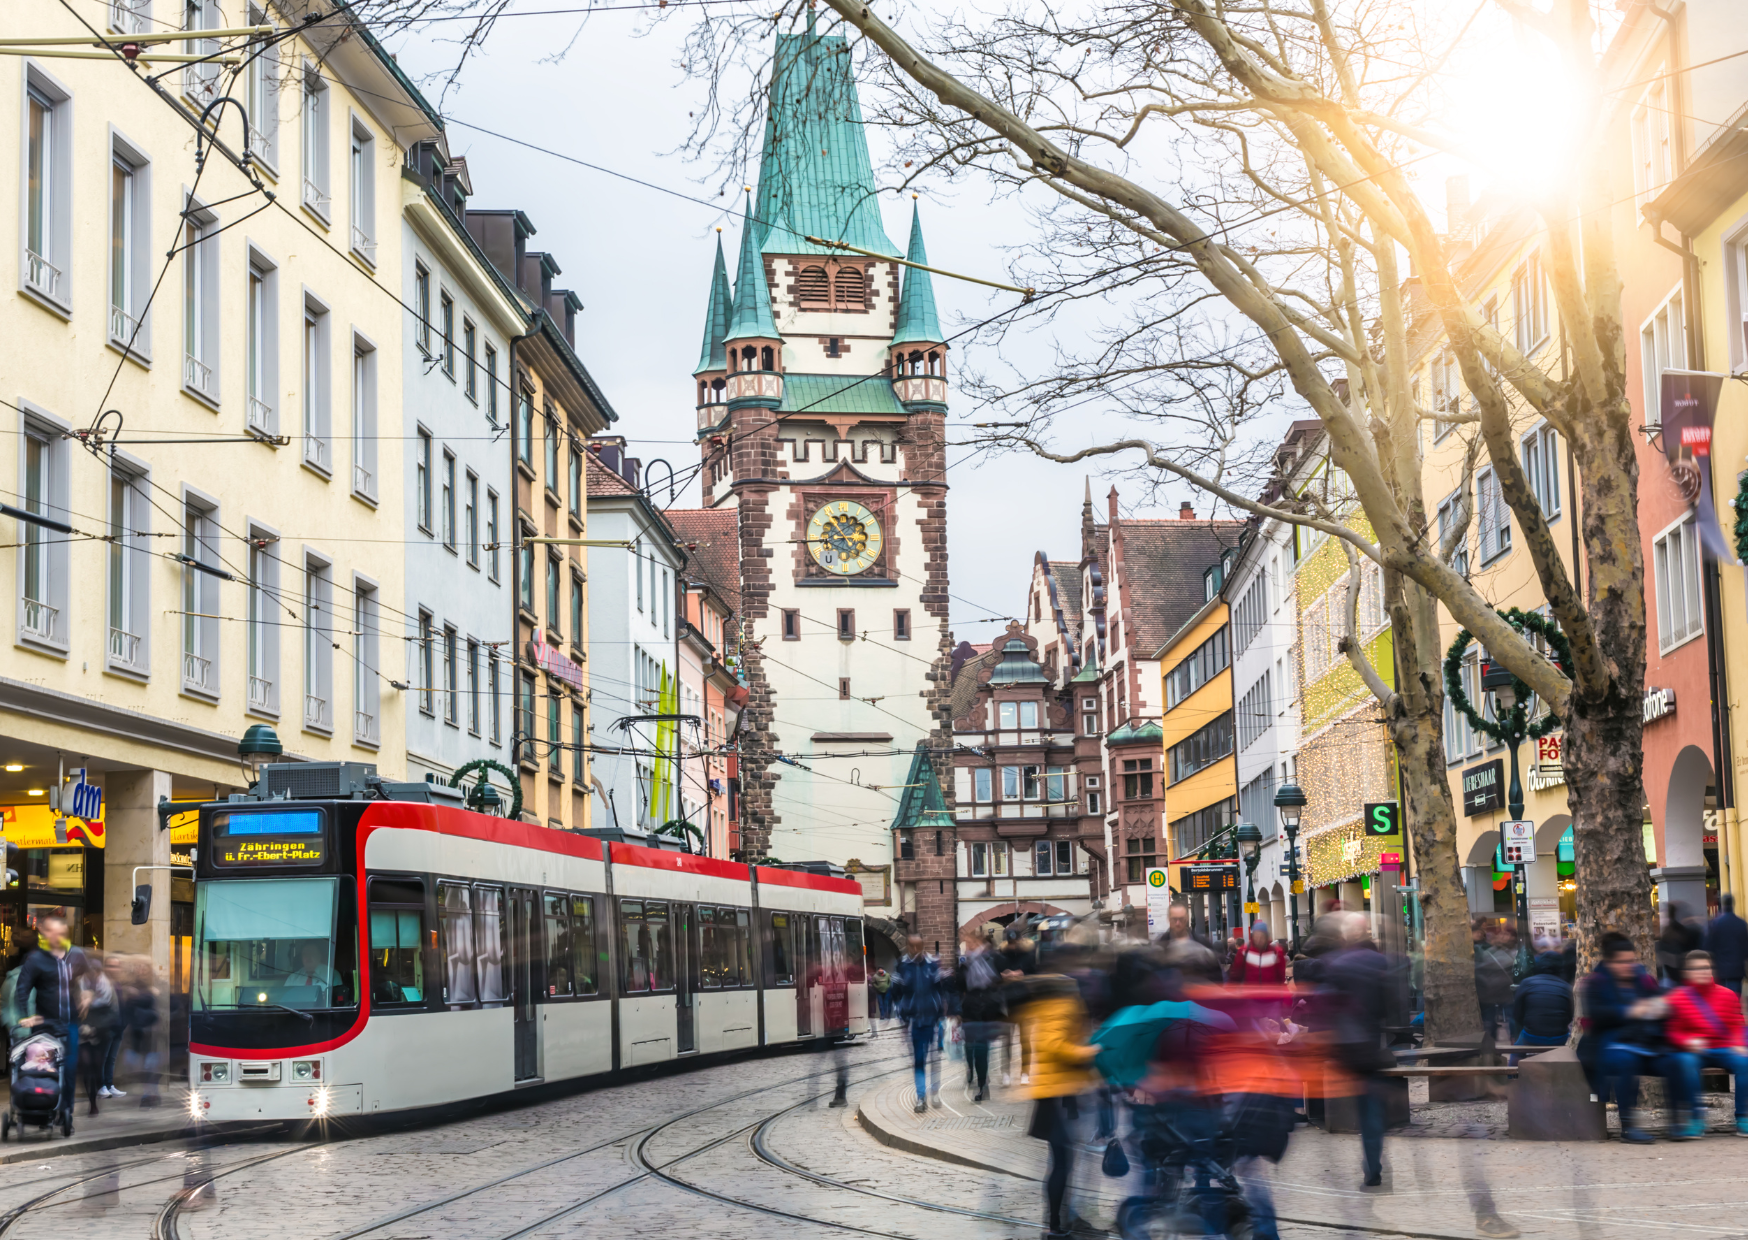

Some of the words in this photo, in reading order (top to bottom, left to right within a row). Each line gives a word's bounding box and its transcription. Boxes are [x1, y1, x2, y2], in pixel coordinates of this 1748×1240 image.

[1642, 686, 1669, 724] afone
[1539, 749, 1562, 761] FO
[73, 768, 102, 819] dm
[1372, 805, 1392, 833] S
[1702, 810, 1718, 832] Fo
[239, 841, 306, 853] Zähringen
[1702, 834, 1718, 844] as
[225, 852, 236, 861] ü.
[237, 850, 321, 861] Fr.-Ebert-Platz
